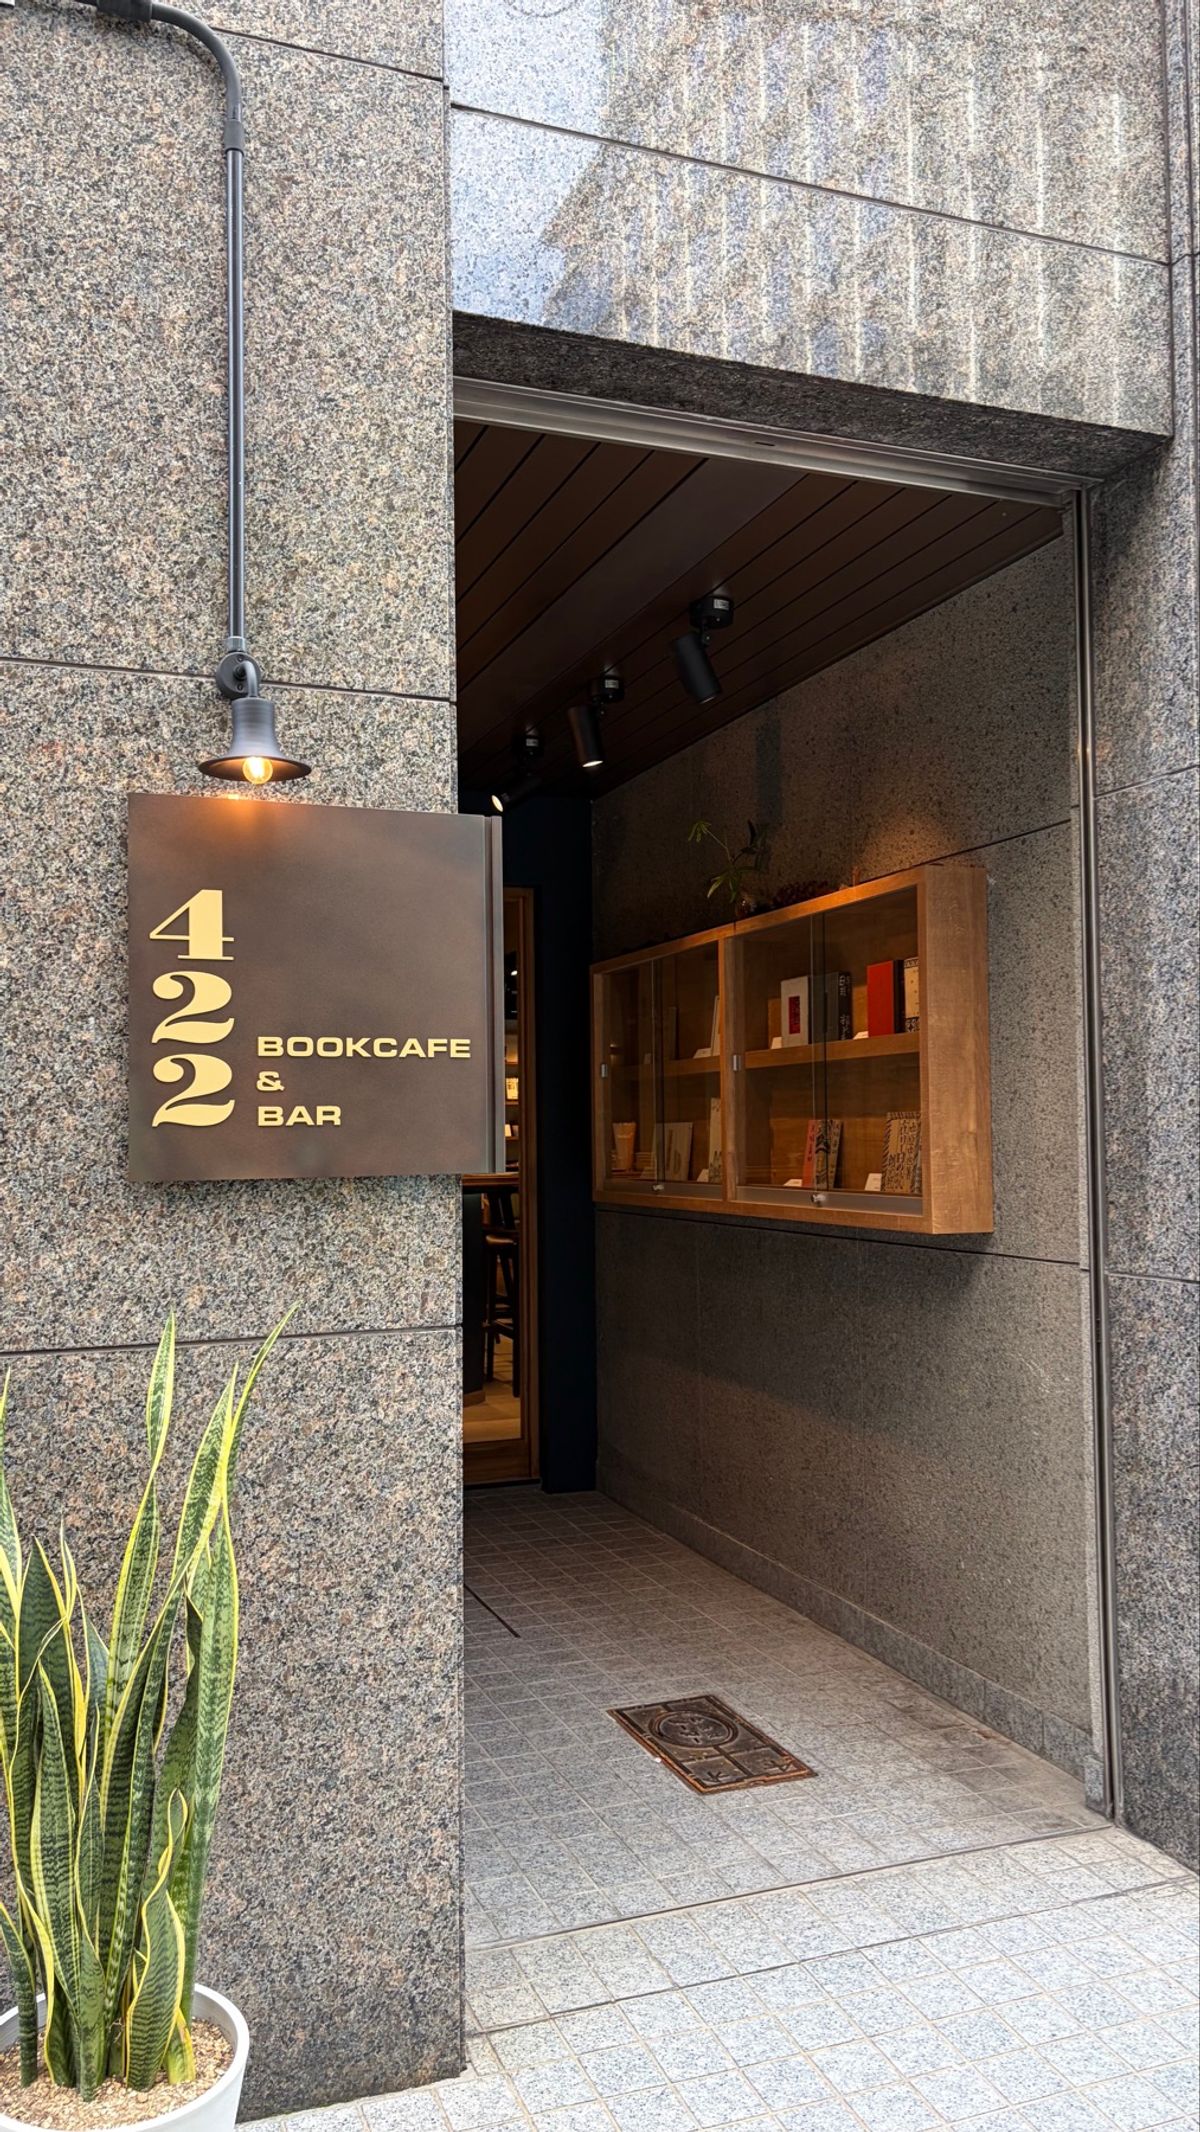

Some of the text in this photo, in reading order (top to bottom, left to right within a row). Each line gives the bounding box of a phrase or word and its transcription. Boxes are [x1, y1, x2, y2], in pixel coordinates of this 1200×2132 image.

[149, 889, 235, 1127] 422
[257, 1036, 471, 1058] BOOKCAFE
[256, 1070, 285, 1091] &
[257, 1105, 342, 1127] BAR
